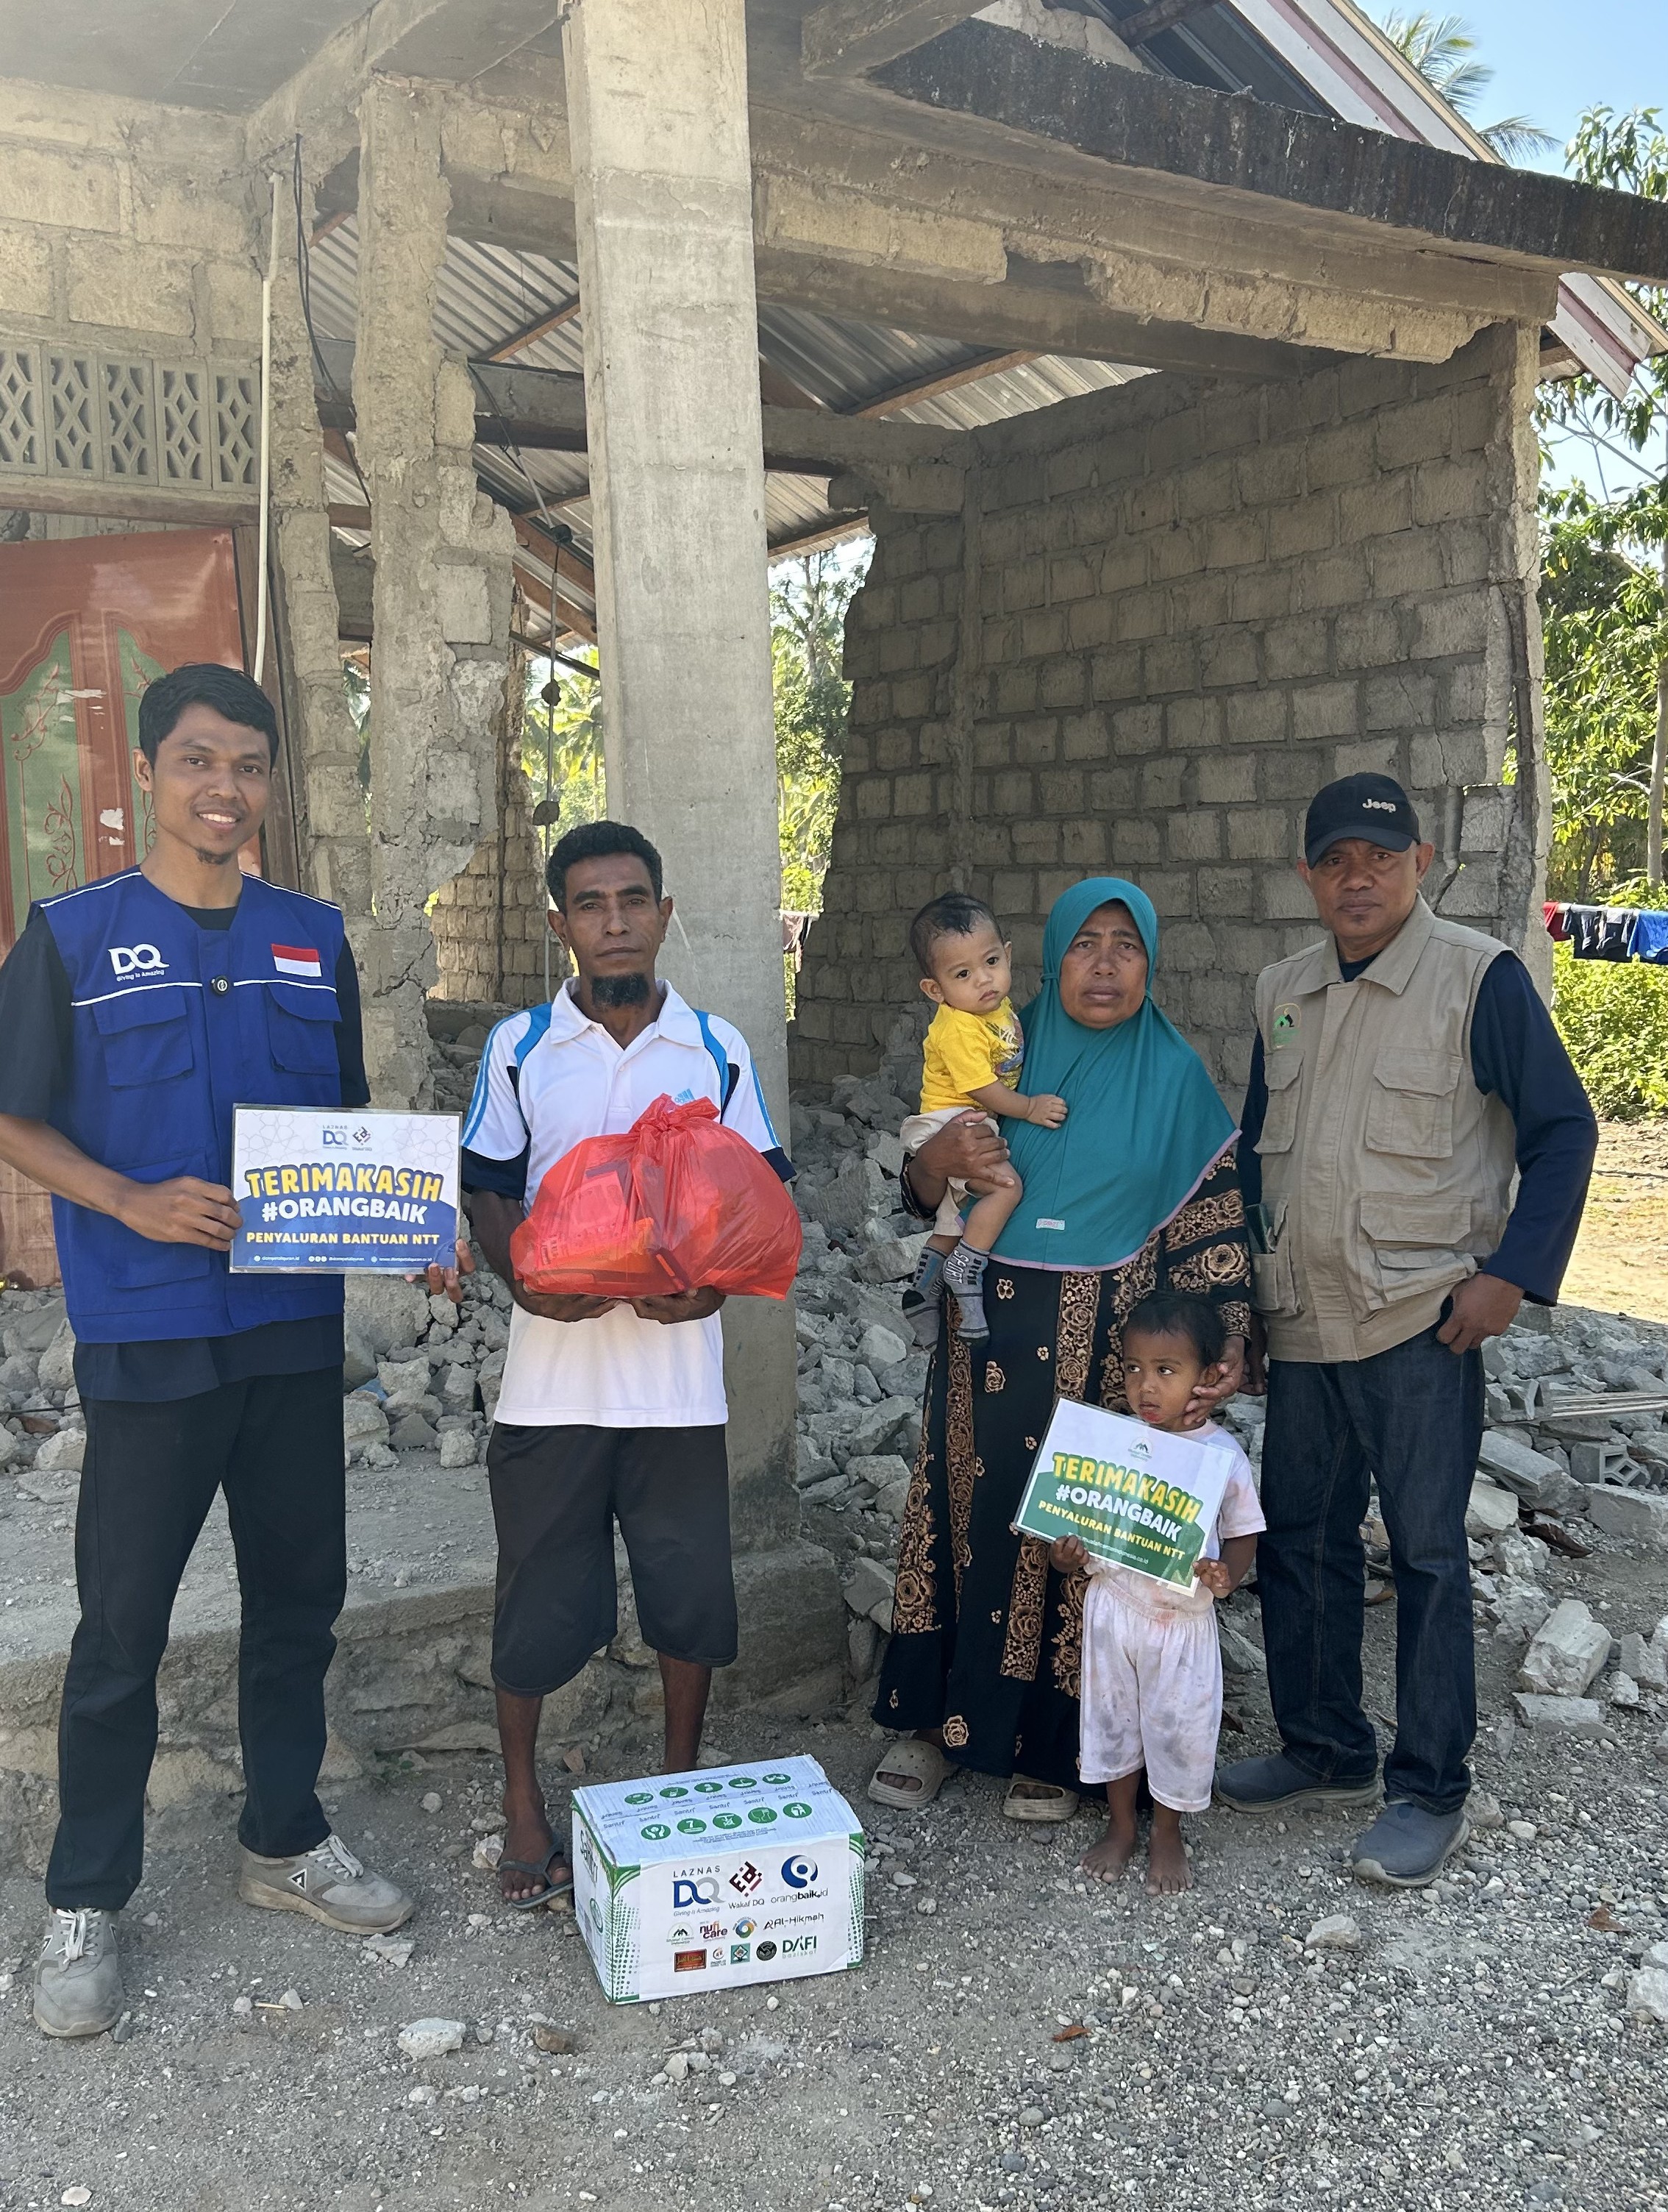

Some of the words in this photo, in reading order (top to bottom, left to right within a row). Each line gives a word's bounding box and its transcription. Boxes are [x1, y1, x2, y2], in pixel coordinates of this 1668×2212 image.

[1362, 798, 1396, 813] Jeep
[107, 943, 170, 975] DQ
[322, 1130, 349, 1145] DQ
[246, 1164, 443, 1202] TERIMAKASIH
[262, 1197, 428, 1225] #ORANGBAIK
[246, 1232, 338, 1245] PENYALURAN
[342, 1233, 408, 1245] BANTUAN
[413, 1234, 440, 1245] NTT
[945, 1250, 969, 1284] SPORT
[1053, 1452, 1203, 1524] TERIMAKASIH
[1055, 1484, 1182, 1542] #ORANGBAIK
[1038, 1500, 1112, 1535] PENYALURAN
[1113, 1528, 1161, 1553] BANTUAN
[1163, 1546, 1186, 1561] NTT
[673, 1865, 721, 1878] LAZNAS
[671, 1877, 726, 1908] DQ
[771, 1888, 828, 1904] orangbaik.id
[728, 1899, 750, 1909] Wakaf
[752, 1898, 765, 1907] DQ
[774, 1913, 824, 1929] Al-Hikmah
[703, 1929, 727, 1939] care
[783, 1935, 816, 1953] DAFI
